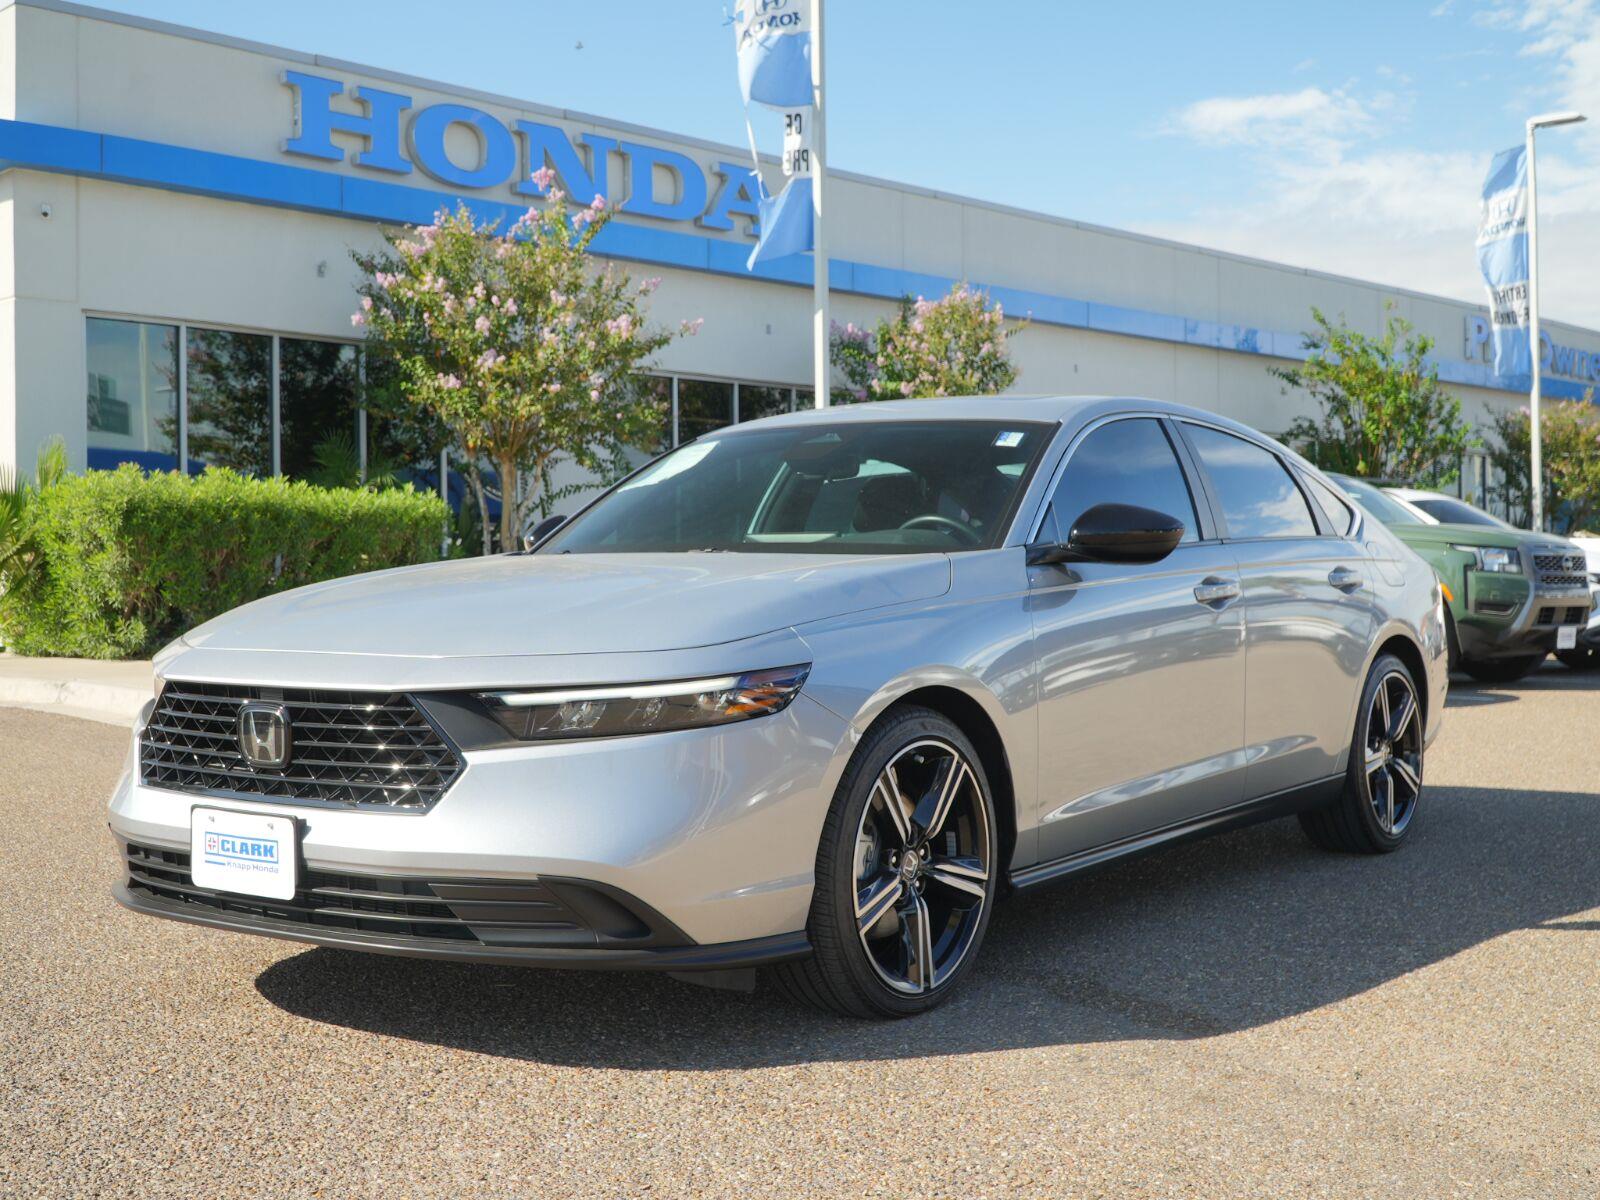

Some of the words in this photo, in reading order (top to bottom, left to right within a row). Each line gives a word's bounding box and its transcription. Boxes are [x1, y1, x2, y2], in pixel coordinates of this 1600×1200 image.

[281, 70, 769, 238] HONDA
[220, 839, 275, 858] CLARK
[226, 861, 251, 871] Knapp
[252, 863, 279, 874] Honda
